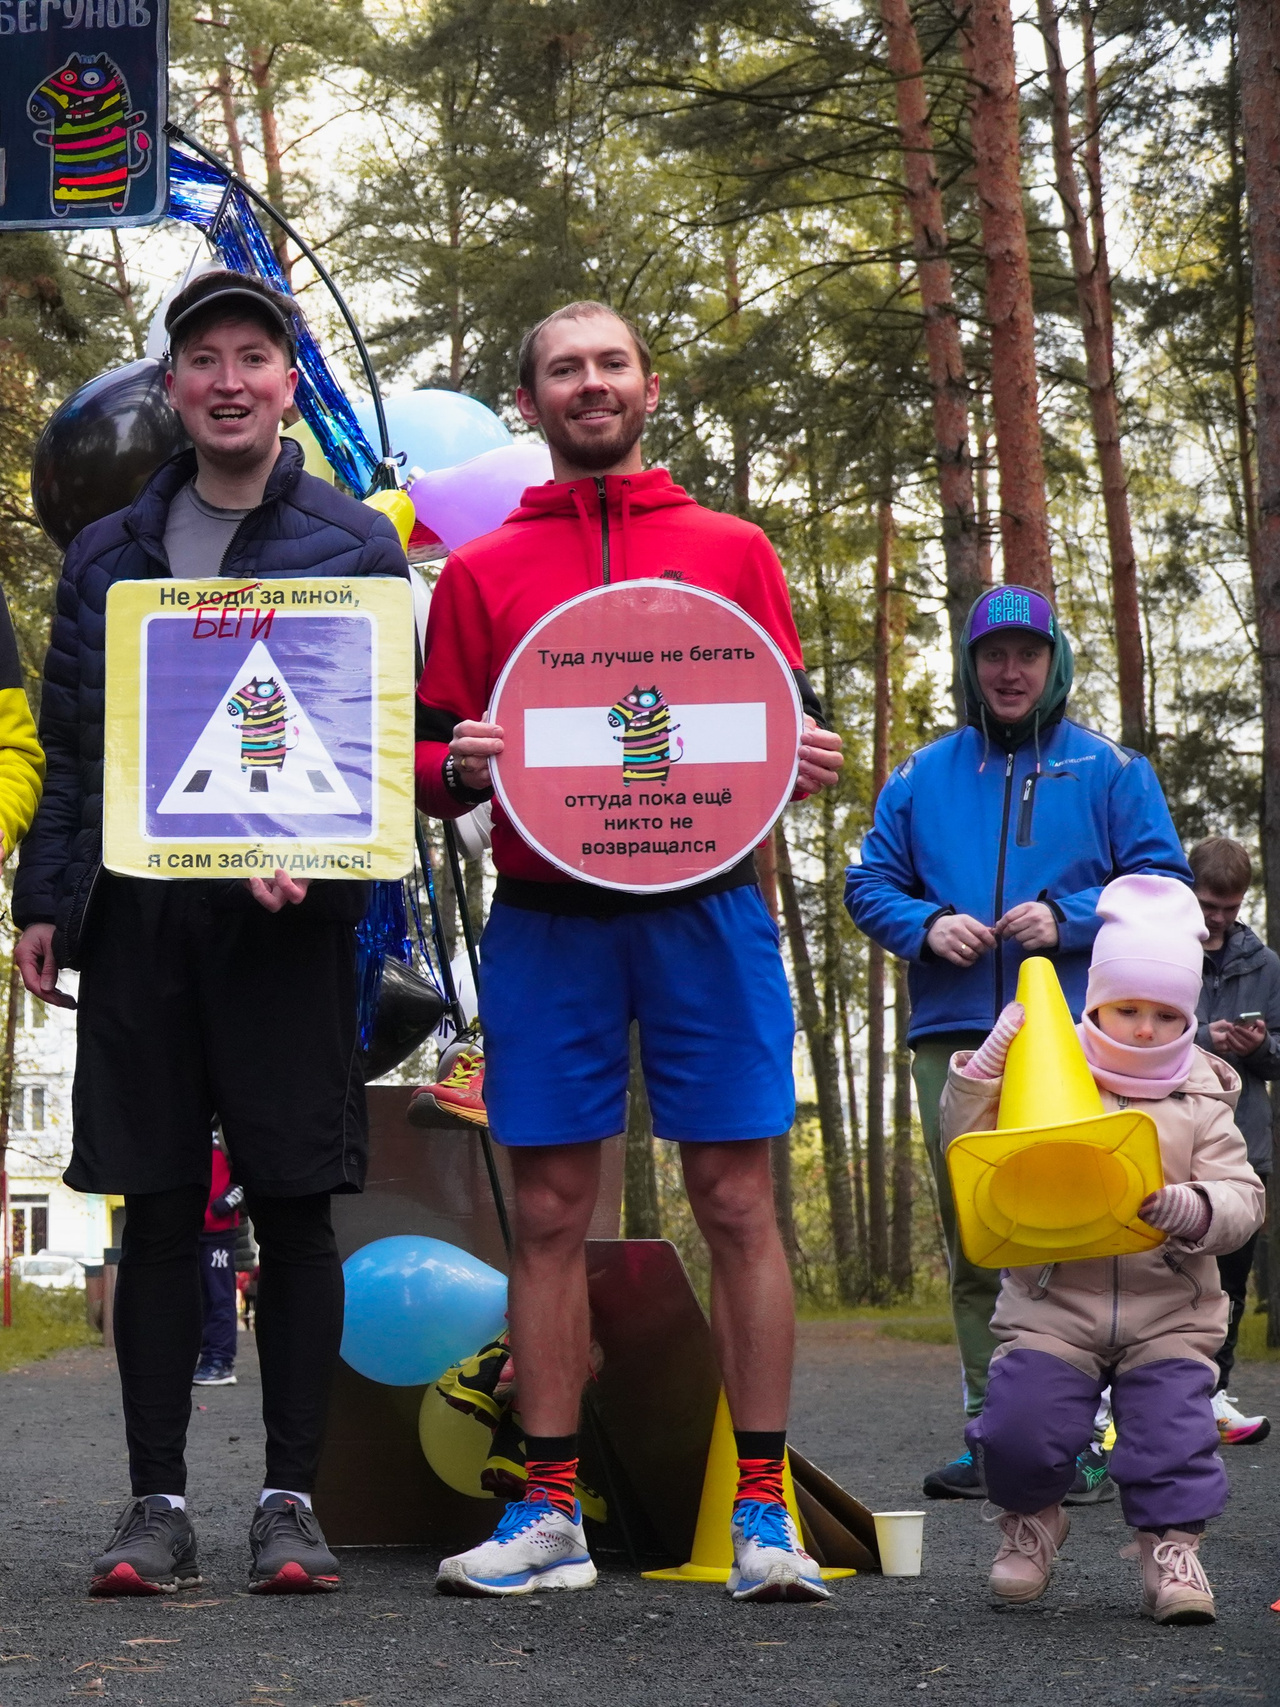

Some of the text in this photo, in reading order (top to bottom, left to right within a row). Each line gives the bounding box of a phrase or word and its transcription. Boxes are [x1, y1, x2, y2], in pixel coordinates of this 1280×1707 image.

[663, 569, 684, 579] NIKE
[160, 588, 190, 606] Не
[260, 590, 285, 605] за
[291, 585, 360, 608] мной,
[192, 608, 276, 640] БЕГИ
[537, 644, 755, 669] Туда лучше не бегать
[564, 788, 732, 811] оттуда пока ещё
[604, 815, 693, 831] никто не
[581, 838, 716, 858] возвращался
[147, 850, 372, 872] я сам заблудился!
[210, 1248, 229, 1269] NY
